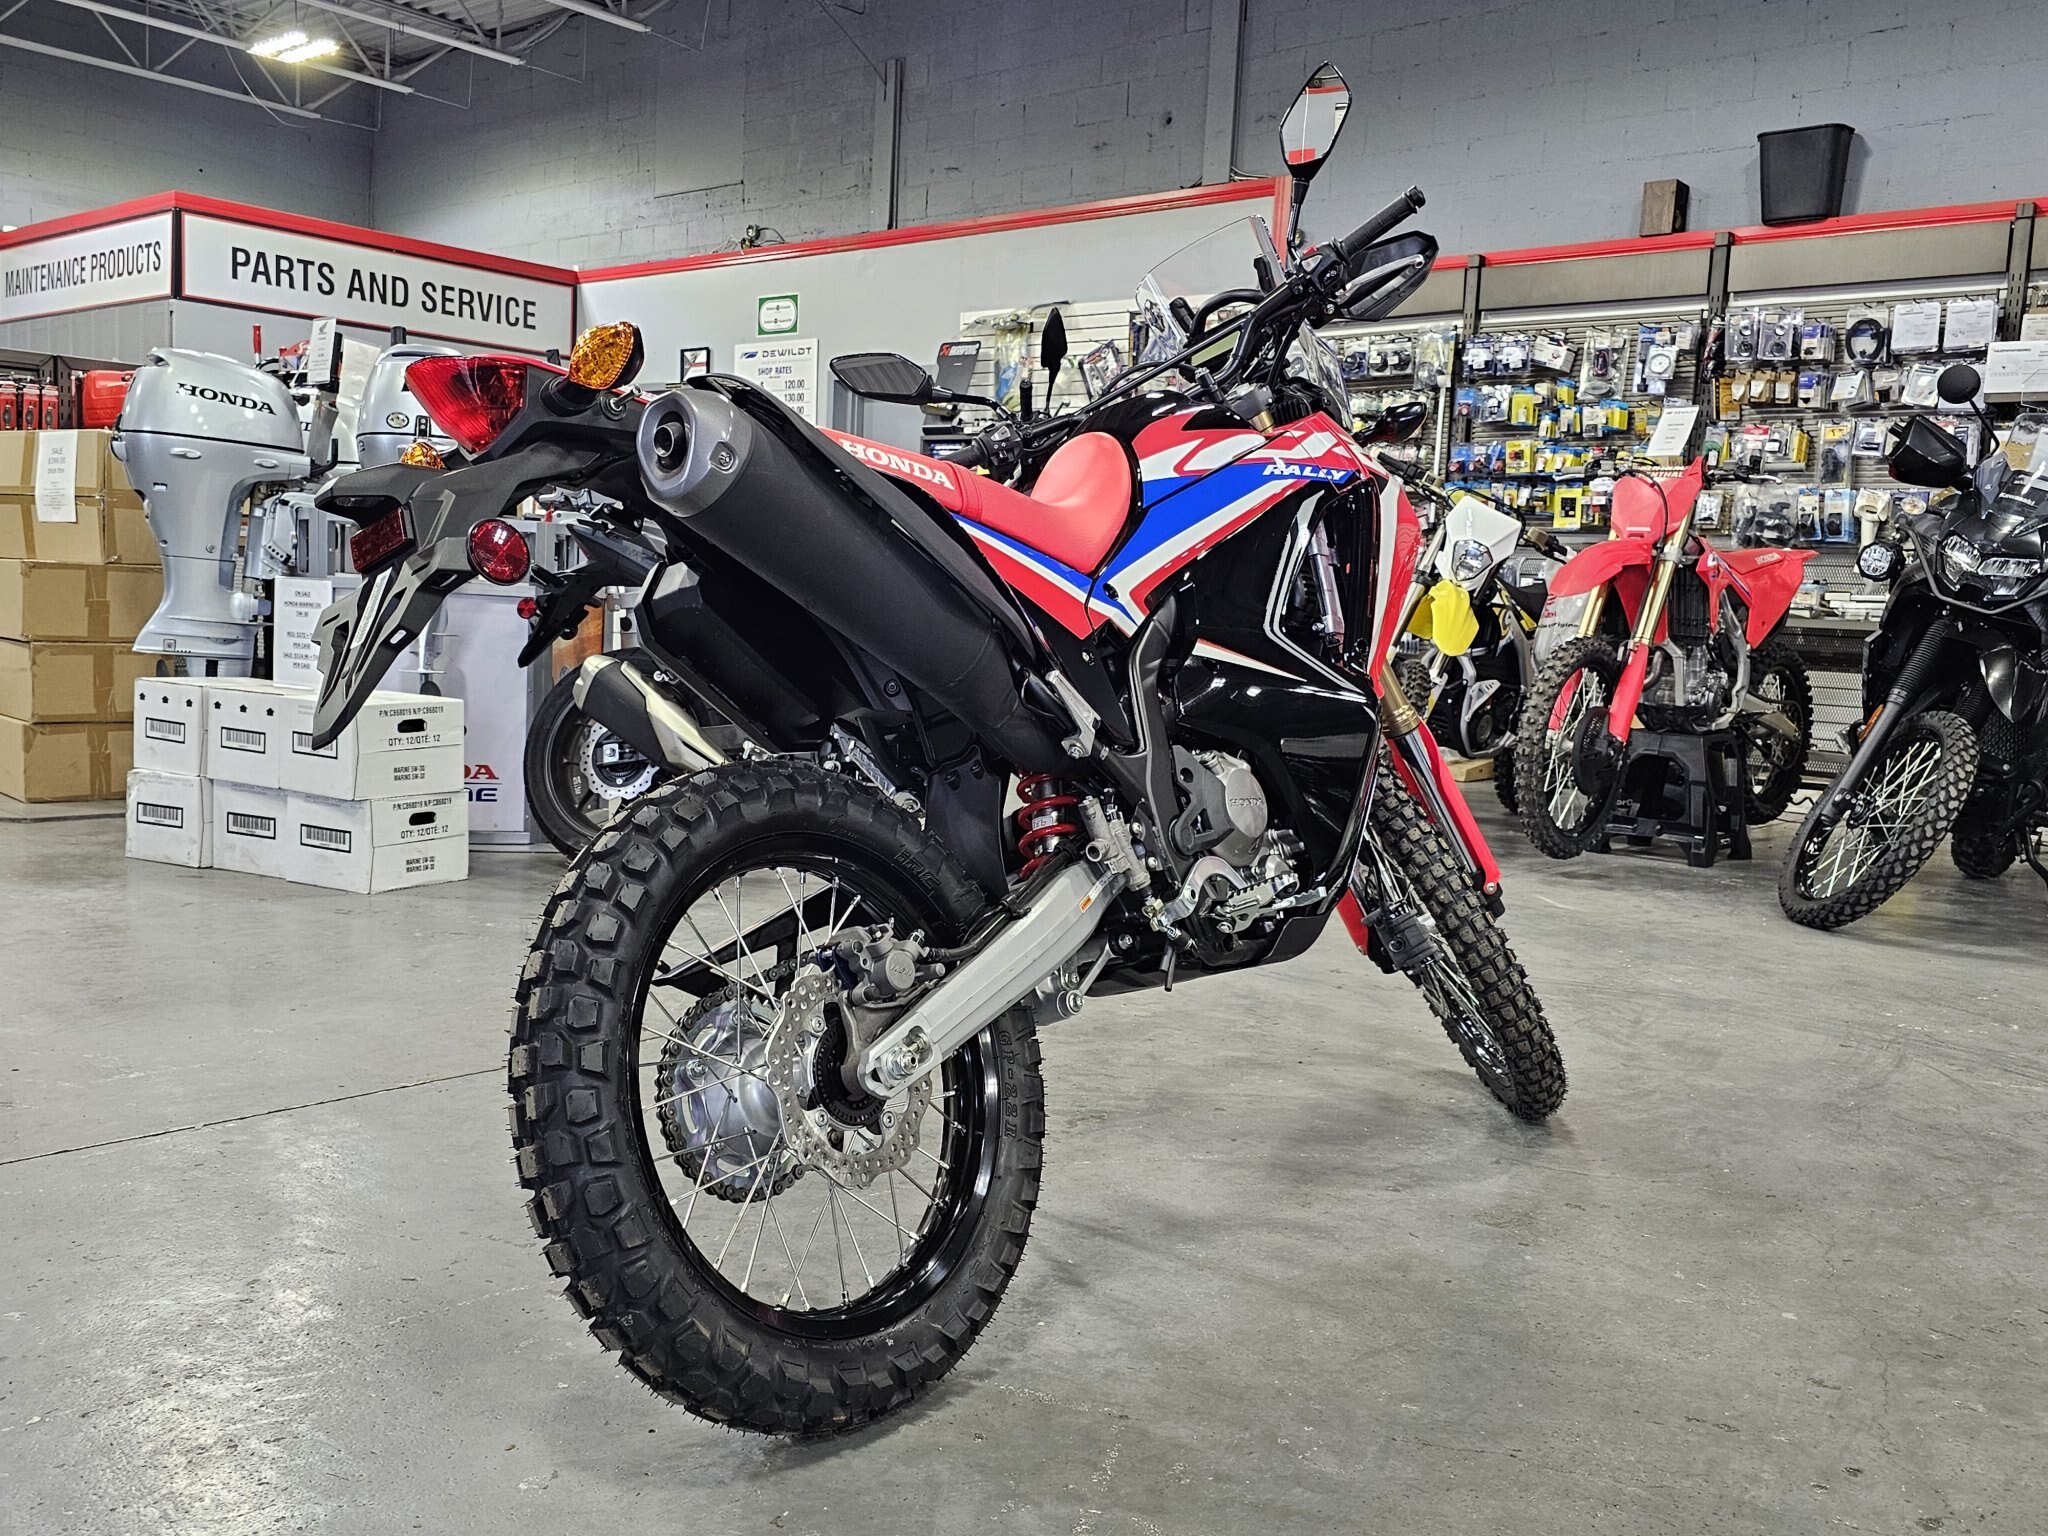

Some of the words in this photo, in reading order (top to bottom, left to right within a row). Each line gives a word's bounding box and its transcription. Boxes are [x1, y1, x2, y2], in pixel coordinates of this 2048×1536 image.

[5, 255, 86, 298] MAINTENANCE
[90, 240, 162, 283] PRODUCTS
[230, 246, 336, 296] PARTS
[346, 268, 409, 308] AND
[421, 281, 537, 330] SERVICE
[762, 347, 812, 358] DEWILDT
[758, 367, 773, 376] SHOP
[775, 366, 792, 375] RATES
[784, 379, 805, 390] 120.00
[176, 382, 277, 416] HONDA
[784, 392, 805, 402] 130.00
[840, 438, 955, 490] HONDA
[1262, 460, 1348, 481] RALLY
[1998, 492, 2036, 506] Kawasaki
[1754, 552, 1781, 566] HONDA
[388, 738, 404, 746] QTY:
[1230, 797, 1266, 807] HONDA
[400, 830, 415, 839] QTY:
[441, 825, 448, 833] 12
